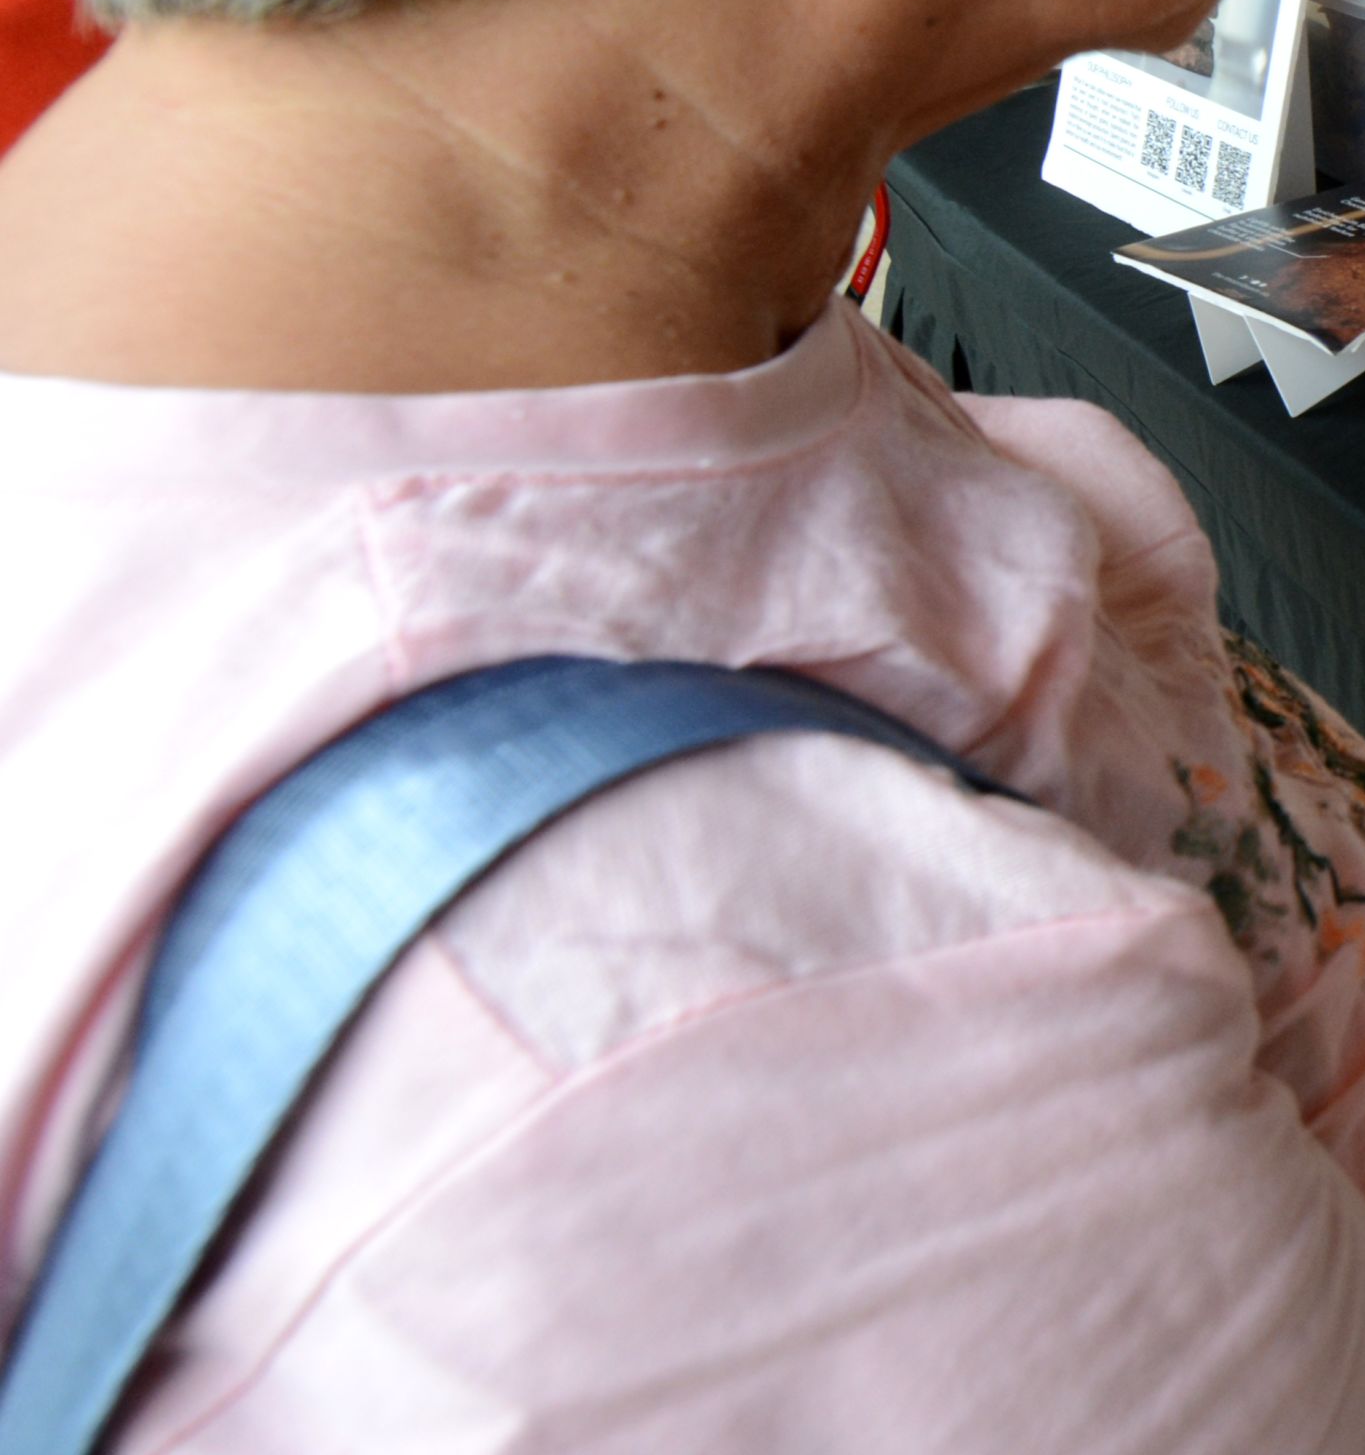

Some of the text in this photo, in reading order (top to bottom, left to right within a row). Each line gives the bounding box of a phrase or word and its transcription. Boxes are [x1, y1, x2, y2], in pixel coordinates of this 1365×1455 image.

[1166, 96, 1199, 120] FOLLOW US
[1217, 119, 1260, 145] CONTACT US
